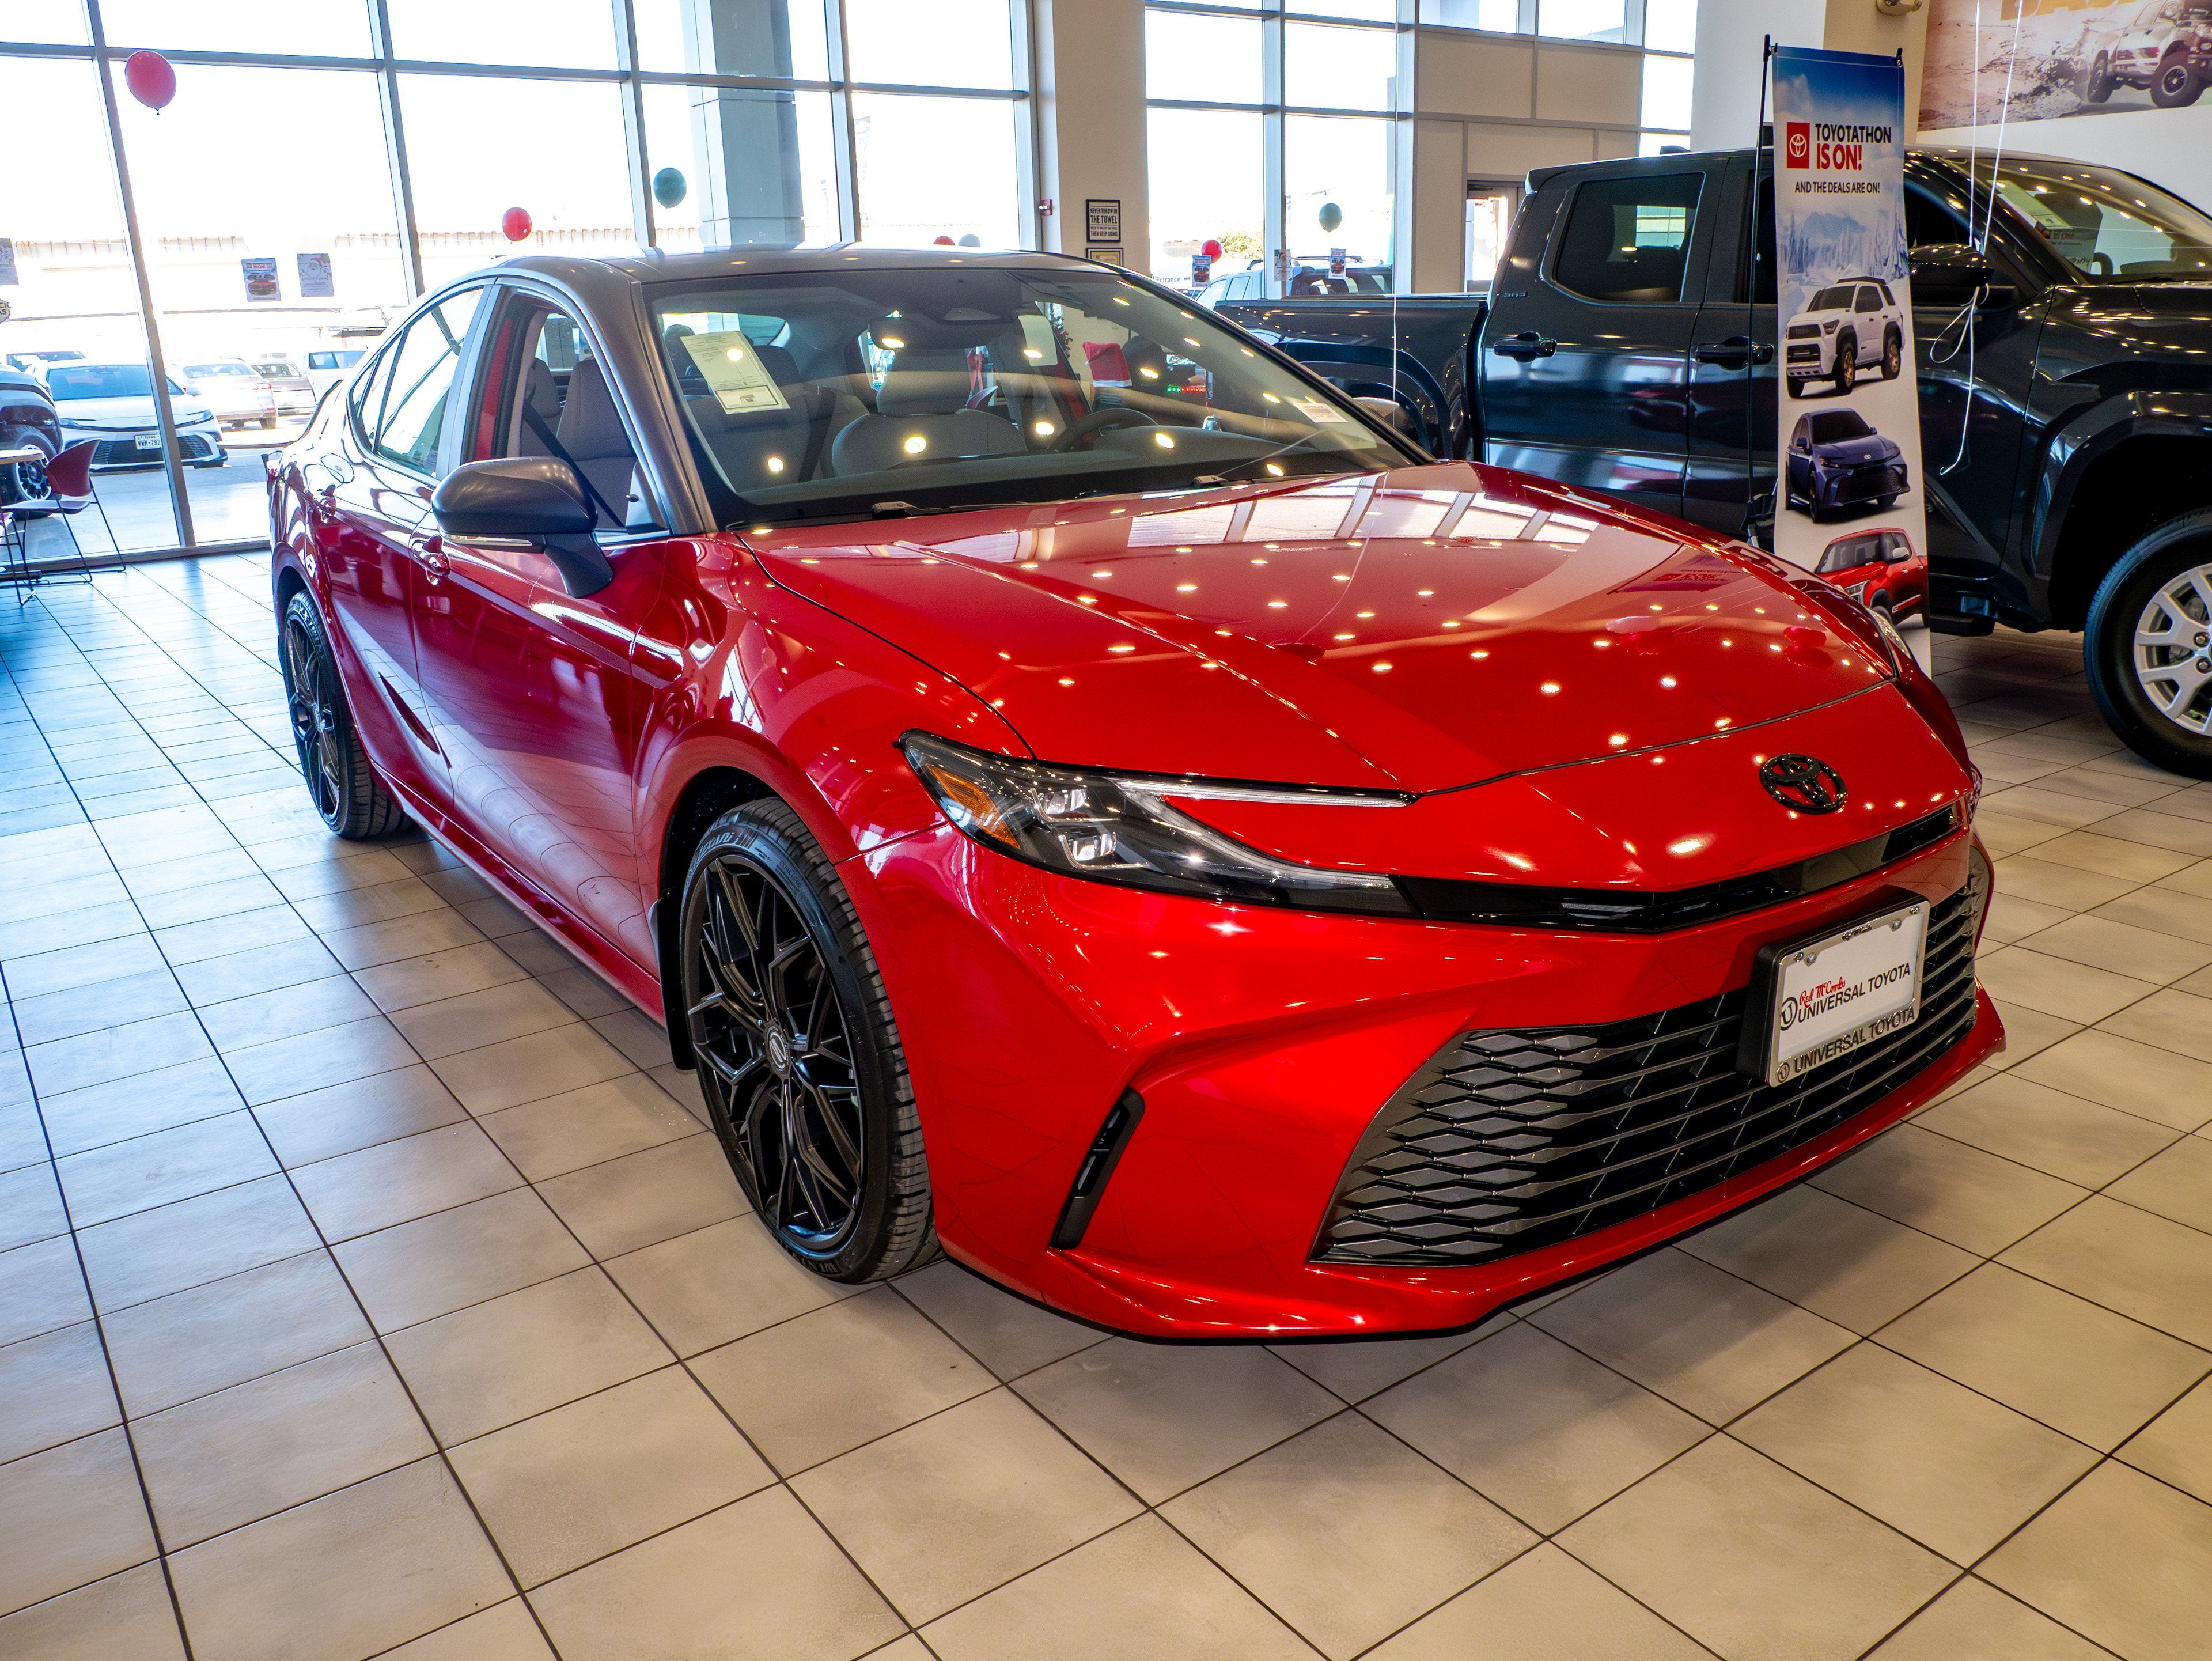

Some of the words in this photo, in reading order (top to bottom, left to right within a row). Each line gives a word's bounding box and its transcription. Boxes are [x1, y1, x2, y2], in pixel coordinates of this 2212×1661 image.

[1815, 123, 1891, 143] TOYOTATHON
[1816, 143, 1830, 169] IS
[1832, 145, 1863, 171] ON!
[1795, 181, 1812, 193] AND
[1813, 181, 1827, 193] THE
[1828, 182, 1850, 194] DEALS
[1851, 183, 1865, 194] ARE
[1866, 183, 1880, 194] ON!
[1101, 215, 1117, 224] TOWEL
[1798, 984, 1866, 1023] UNIVERSAL
[1868, 962, 1910, 993] TOYOTA
[1800, 988, 1814, 1008] Red
[1794, 1030, 1866, 1074] UNIVERSAL
[1868, 1007, 1915, 1039] TOYOTA
